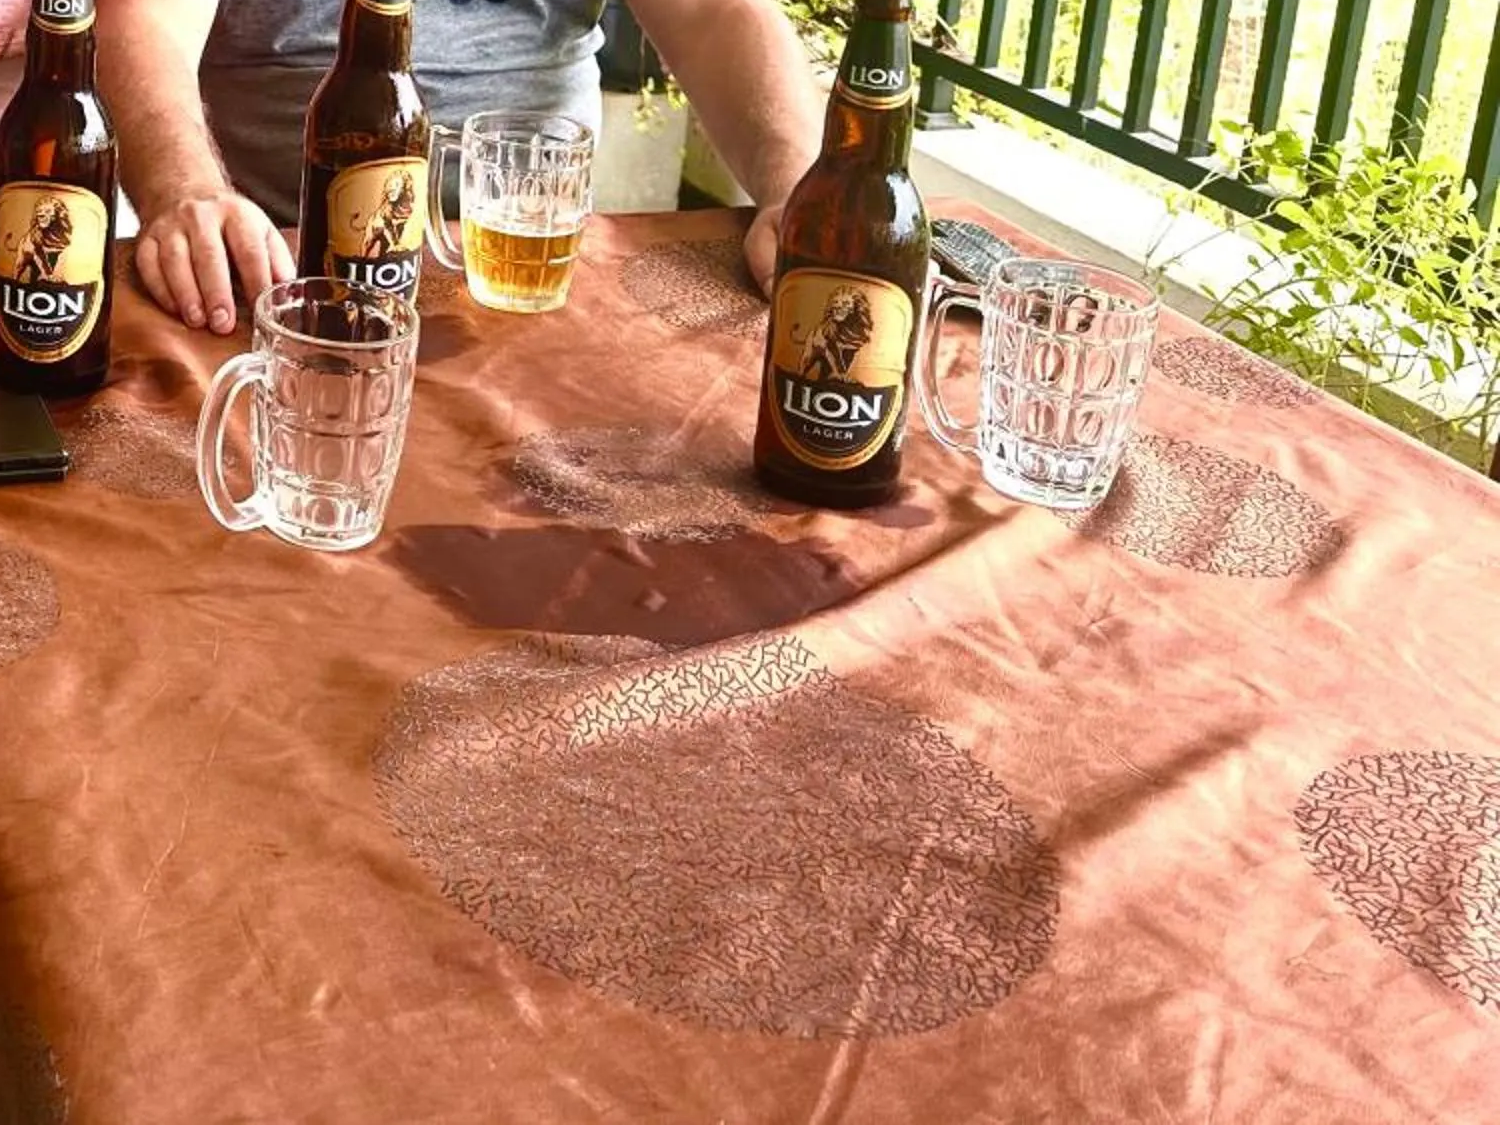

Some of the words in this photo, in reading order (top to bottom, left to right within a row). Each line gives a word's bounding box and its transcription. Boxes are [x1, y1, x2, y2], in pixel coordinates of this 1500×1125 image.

[850, 65, 904, 90] LION
[347, 259, 419, 290] LION
[3, 283, 85, 324] LION
[19, 324, 63, 335] LAGER
[783, 379, 883, 428] LION
[803, 424, 854, 441] LAGER
